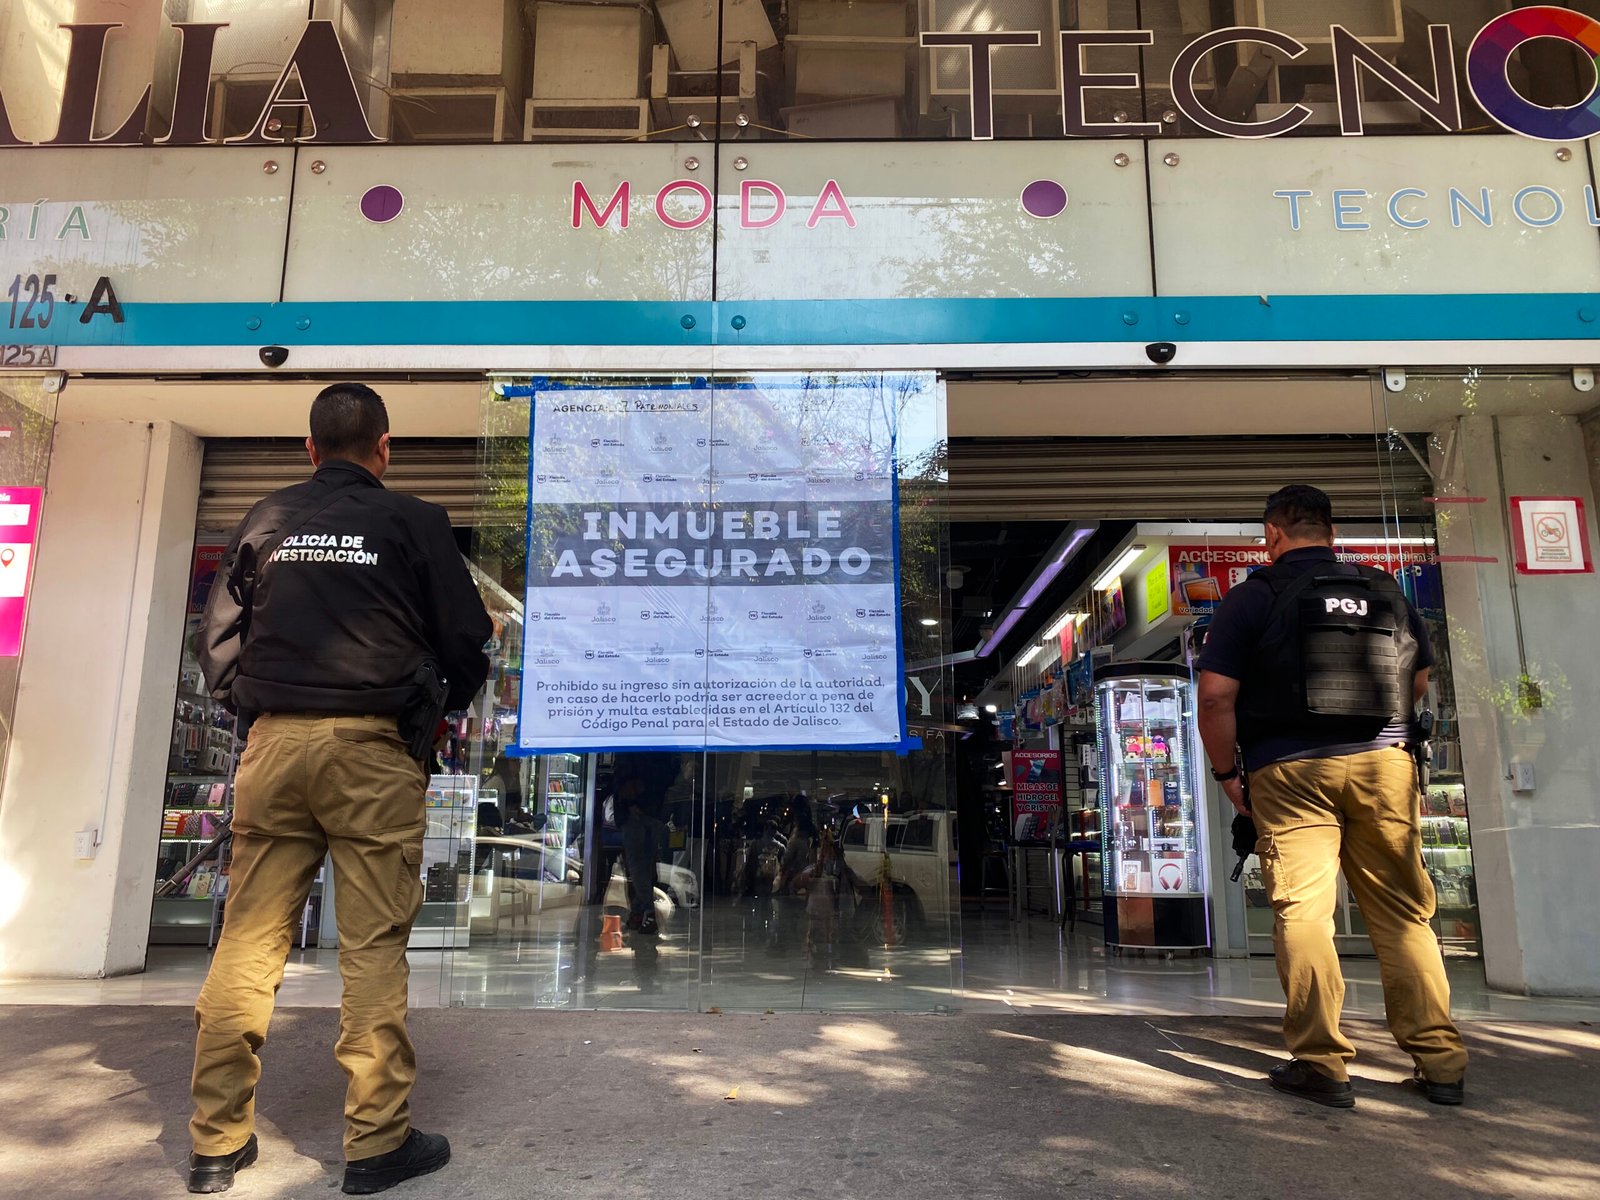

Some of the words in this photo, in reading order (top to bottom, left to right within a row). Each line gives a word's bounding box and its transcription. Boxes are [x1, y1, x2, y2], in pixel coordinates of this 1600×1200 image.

[919, 4, 1600, 141] TECNO
[0, 20, 389, 146] LIA
[571, 179, 858, 230] MODA
[1272, 184, 1600, 231] TECNOL
[8, 274, 57, 329] 125
[583, 510, 842, 540] INMUEBLE
[282, 533, 338, 547] OLICÍA
[340, 535, 365, 549] DE
[268, 549, 379, 566] NVESTIGACIÓN
[551, 547, 872, 578] ASEGURADO
[1336, 553, 1369, 564] amos
[1324, 597, 1368, 616] PGJ
[536, 681, 599, 692] Prohibido
[602, 683, 617, 691] su
[620, 680, 668, 693] ingreso
[671, 680, 691, 690] sin
[693, 678, 777, 690] autorización
[780, 678, 796, 689] de
[800, 678, 812, 689] la
[547, 696, 564, 704] en
[567, 696, 598, 704] caso
[601, 693, 618, 703] de
[621, 692, 671, 703] hacerlo
[674, 691, 718, 705] podría
[721, 693, 742, 702] ser
[745, 691, 807, 702] acreedor
[809, 693, 818, 701] a
[822, 692, 855, 703] pena
[858, 689, 874, 700] de
[548, 706, 593, 720] prisión
[596, 708, 605, 719] y
[608, 706, 648, 716] multa
[651, 704, 736, 716] establecidas
[739, 706, 755, 714] en
[758, 703, 770, 714] el
[773, 702, 827, 714] Artículo
[830, 703, 850, 713] 132
[853, 701, 874, 713] del
[581, 717, 628, 731] Código
[631, 717, 669, 728] Penal
[672, 719, 704, 730] para
[708, 717, 719, 727] el
[723, 716, 769, 727] Estado
[773, 715, 789, 726] de
[792, 715, 842, 726] Jalisco.
[1016, 782, 1046, 791] MICAS
[1016, 793, 1059, 802] HIDROGEL
